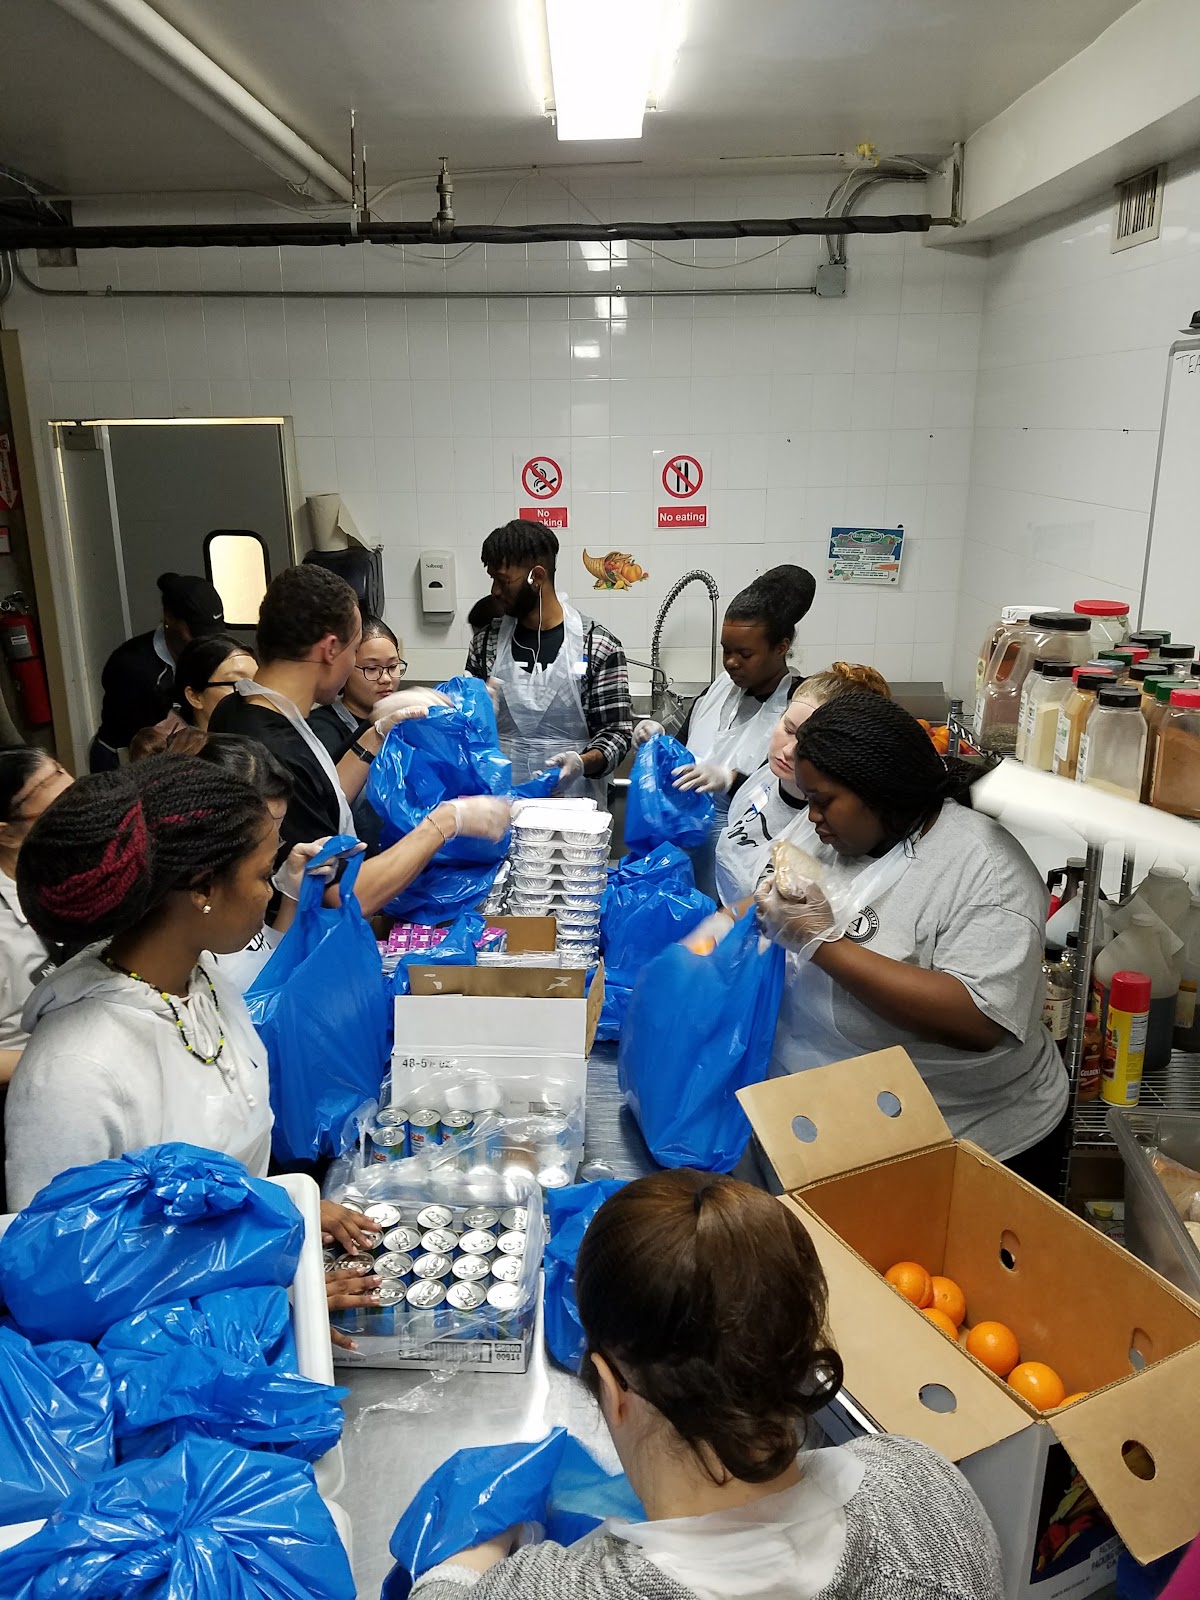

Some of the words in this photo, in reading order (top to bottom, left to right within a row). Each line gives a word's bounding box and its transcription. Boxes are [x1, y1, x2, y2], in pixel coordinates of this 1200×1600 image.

[537, 509, 550, 518] No
[660, 512, 674, 523] No
[675, 512, 706, 523] eating
[496, 1353, 521, 1361] 00914
